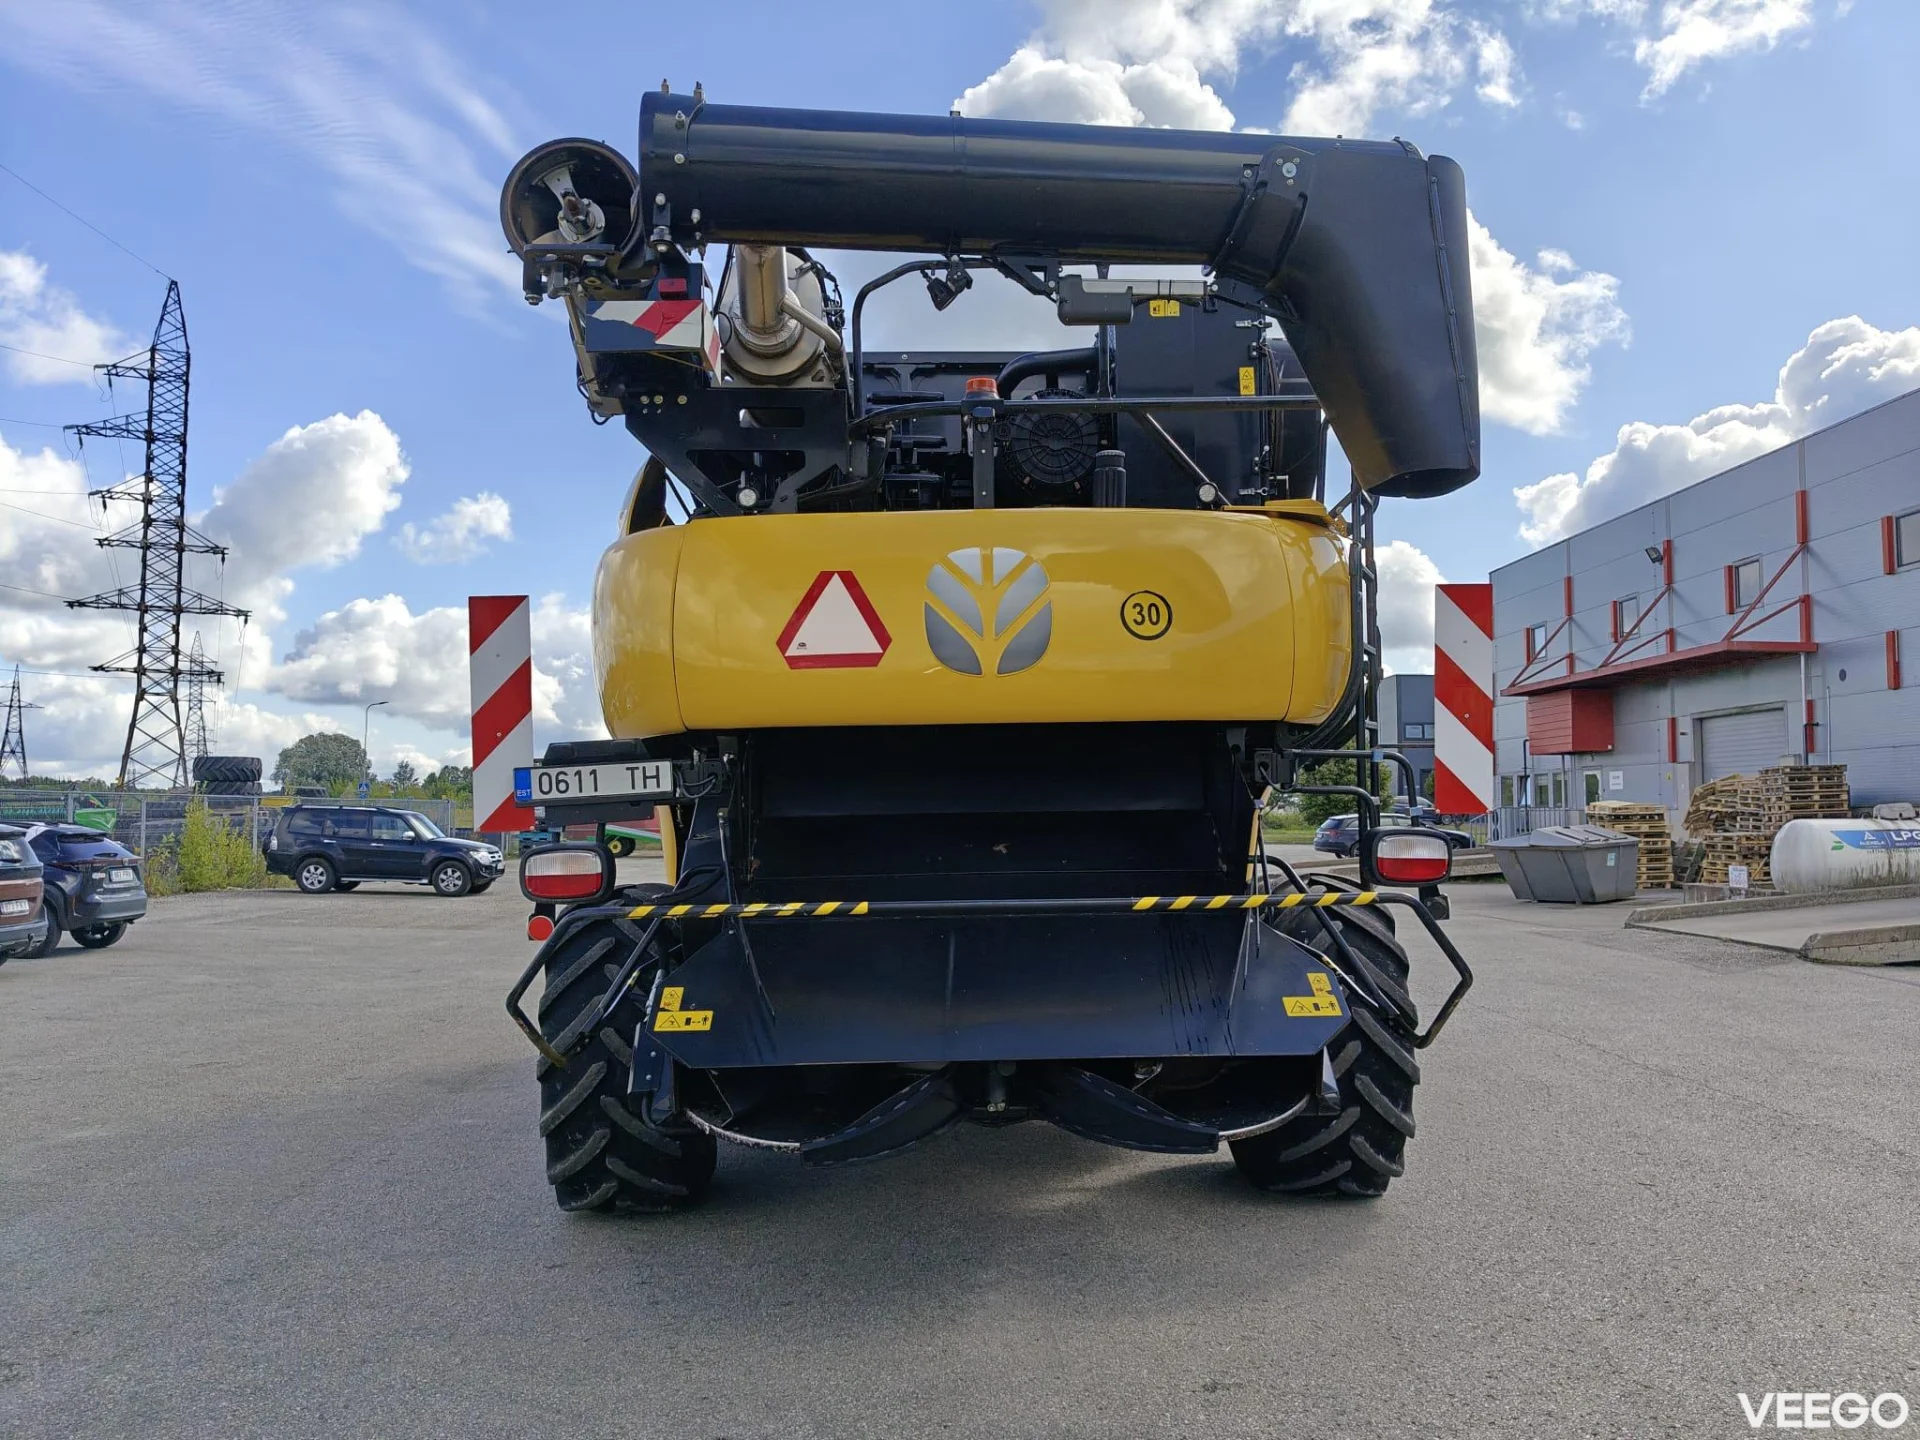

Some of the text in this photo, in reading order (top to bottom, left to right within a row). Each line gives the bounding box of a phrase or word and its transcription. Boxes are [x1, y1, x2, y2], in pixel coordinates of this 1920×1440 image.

[1132, 602, 1160, 626] 30
[538, 765, 660, 795] 0611 TH
[516, 789, 531, 797] EST
